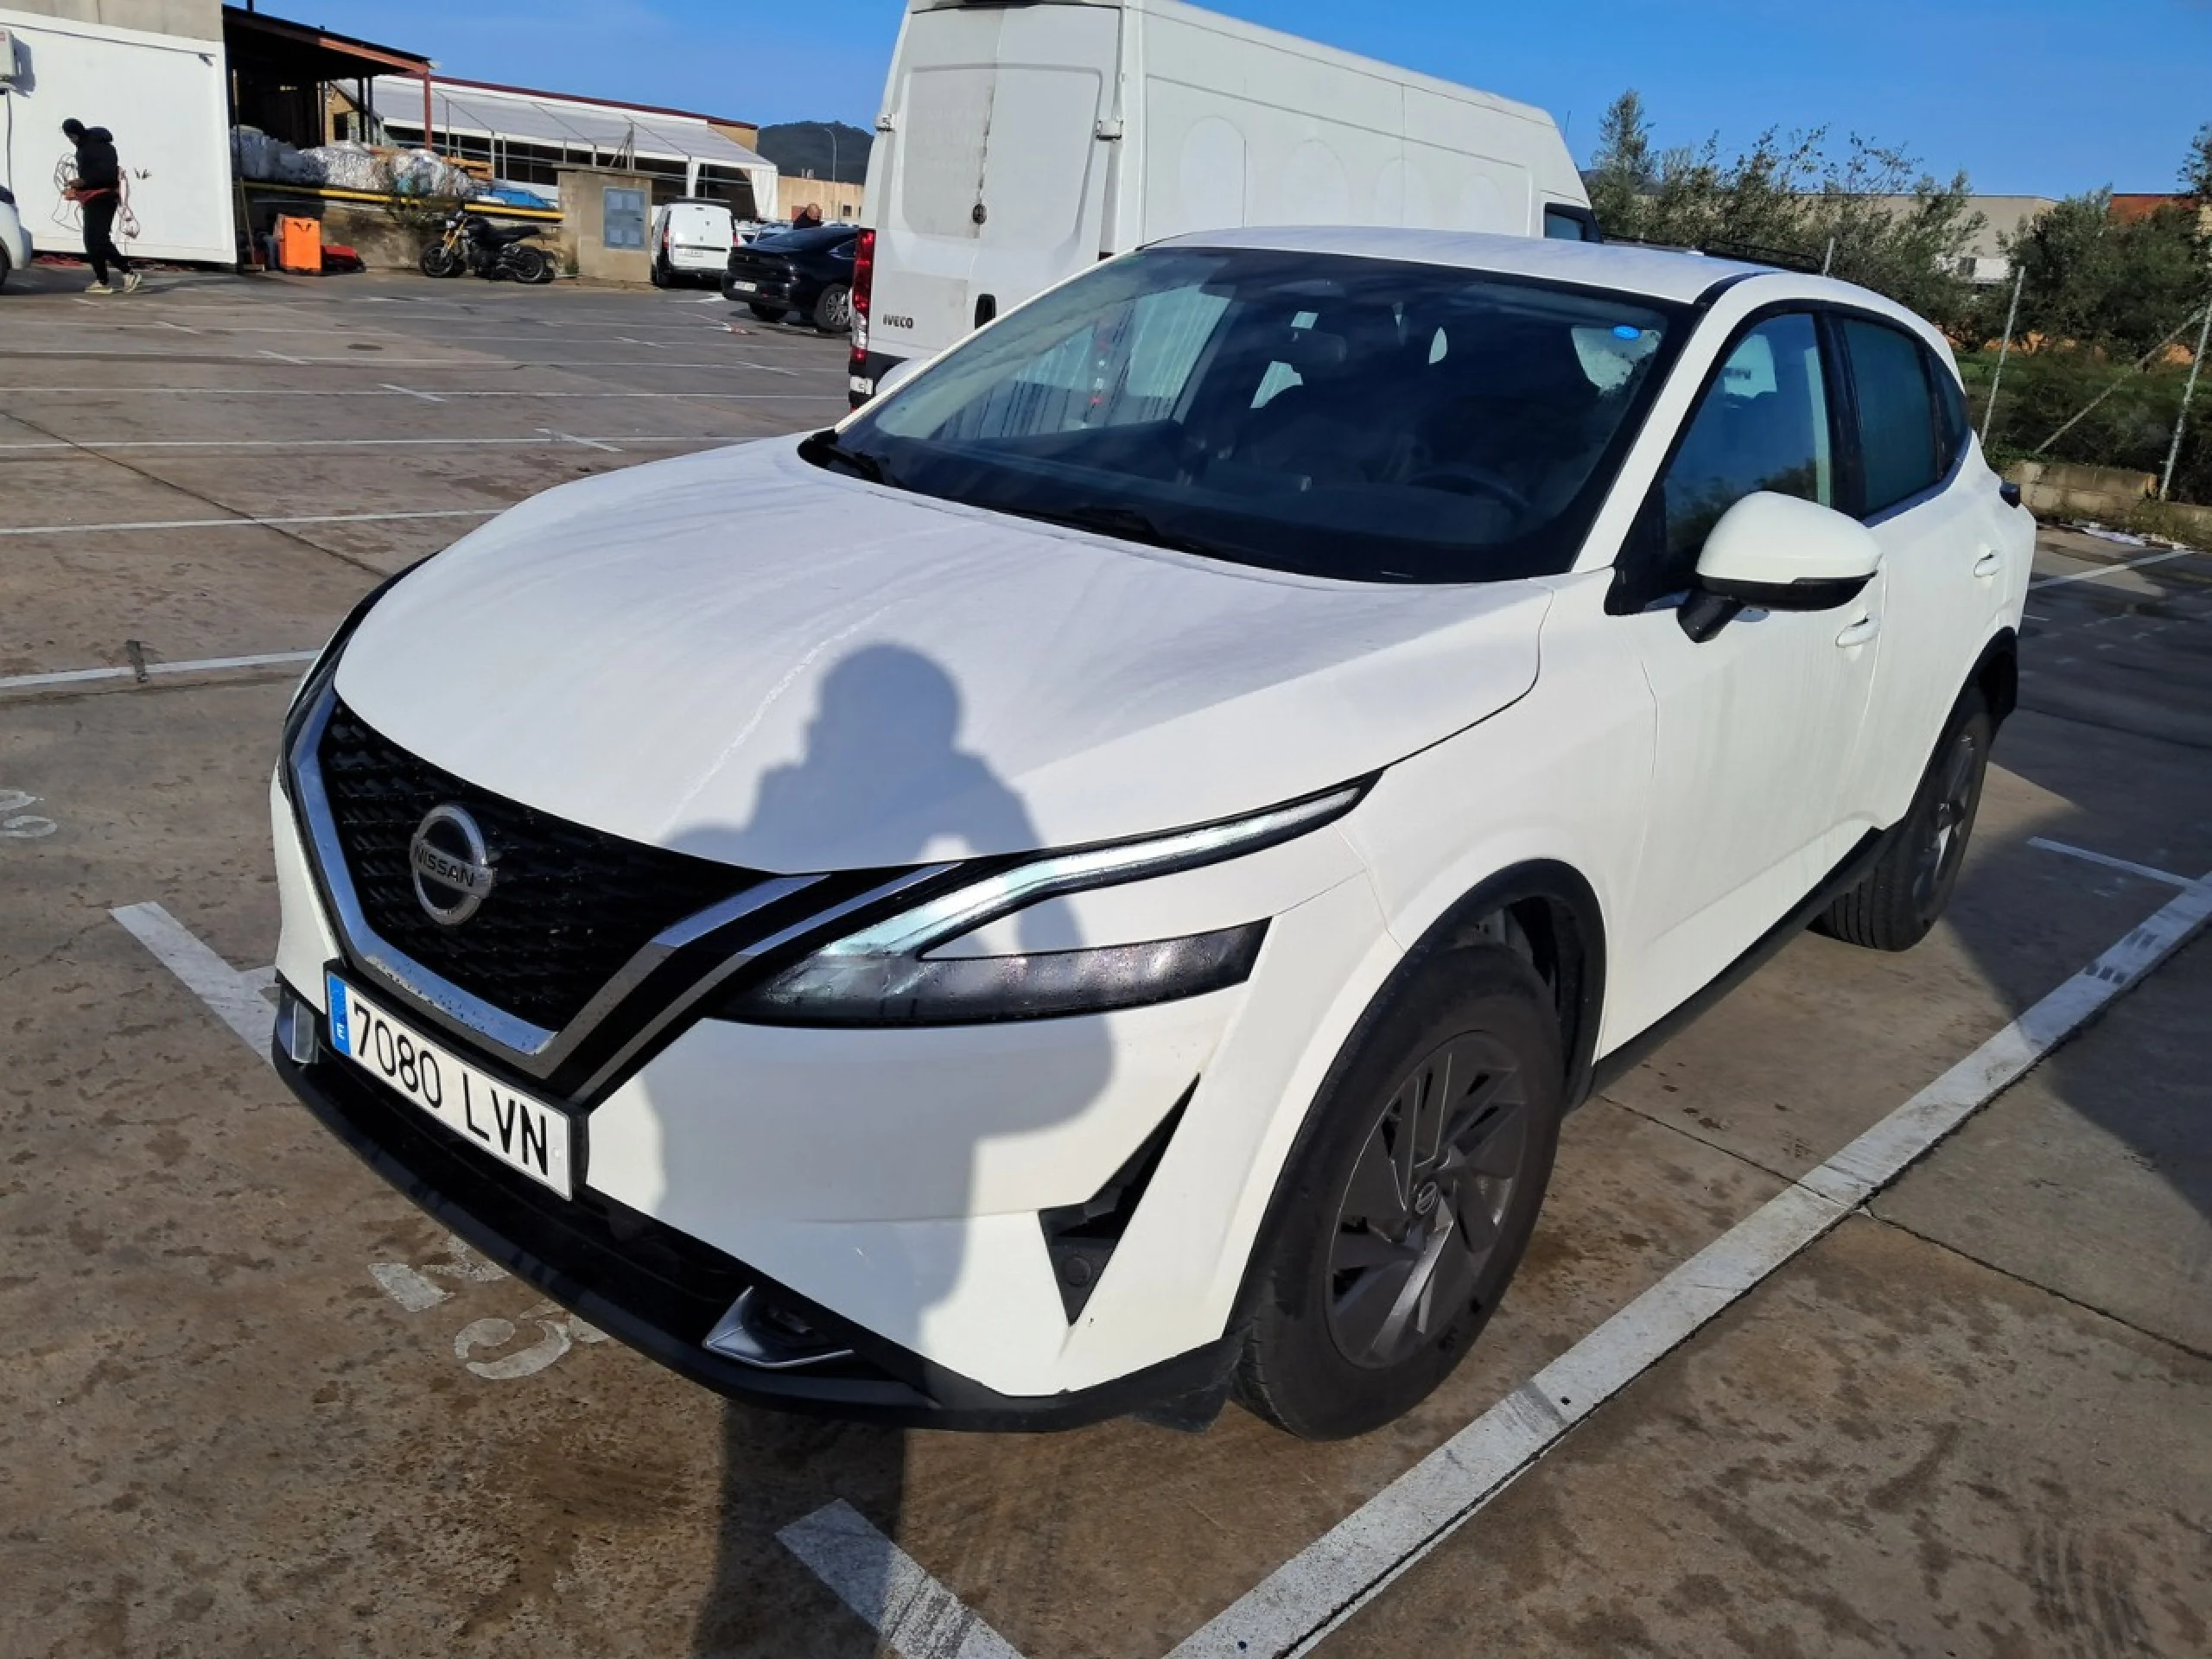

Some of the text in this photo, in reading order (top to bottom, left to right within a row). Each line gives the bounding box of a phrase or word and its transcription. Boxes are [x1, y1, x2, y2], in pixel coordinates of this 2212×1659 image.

[416, 843, 474, 887] NISSAN
[353, 1001, 549, 1177] 7080 LVN
